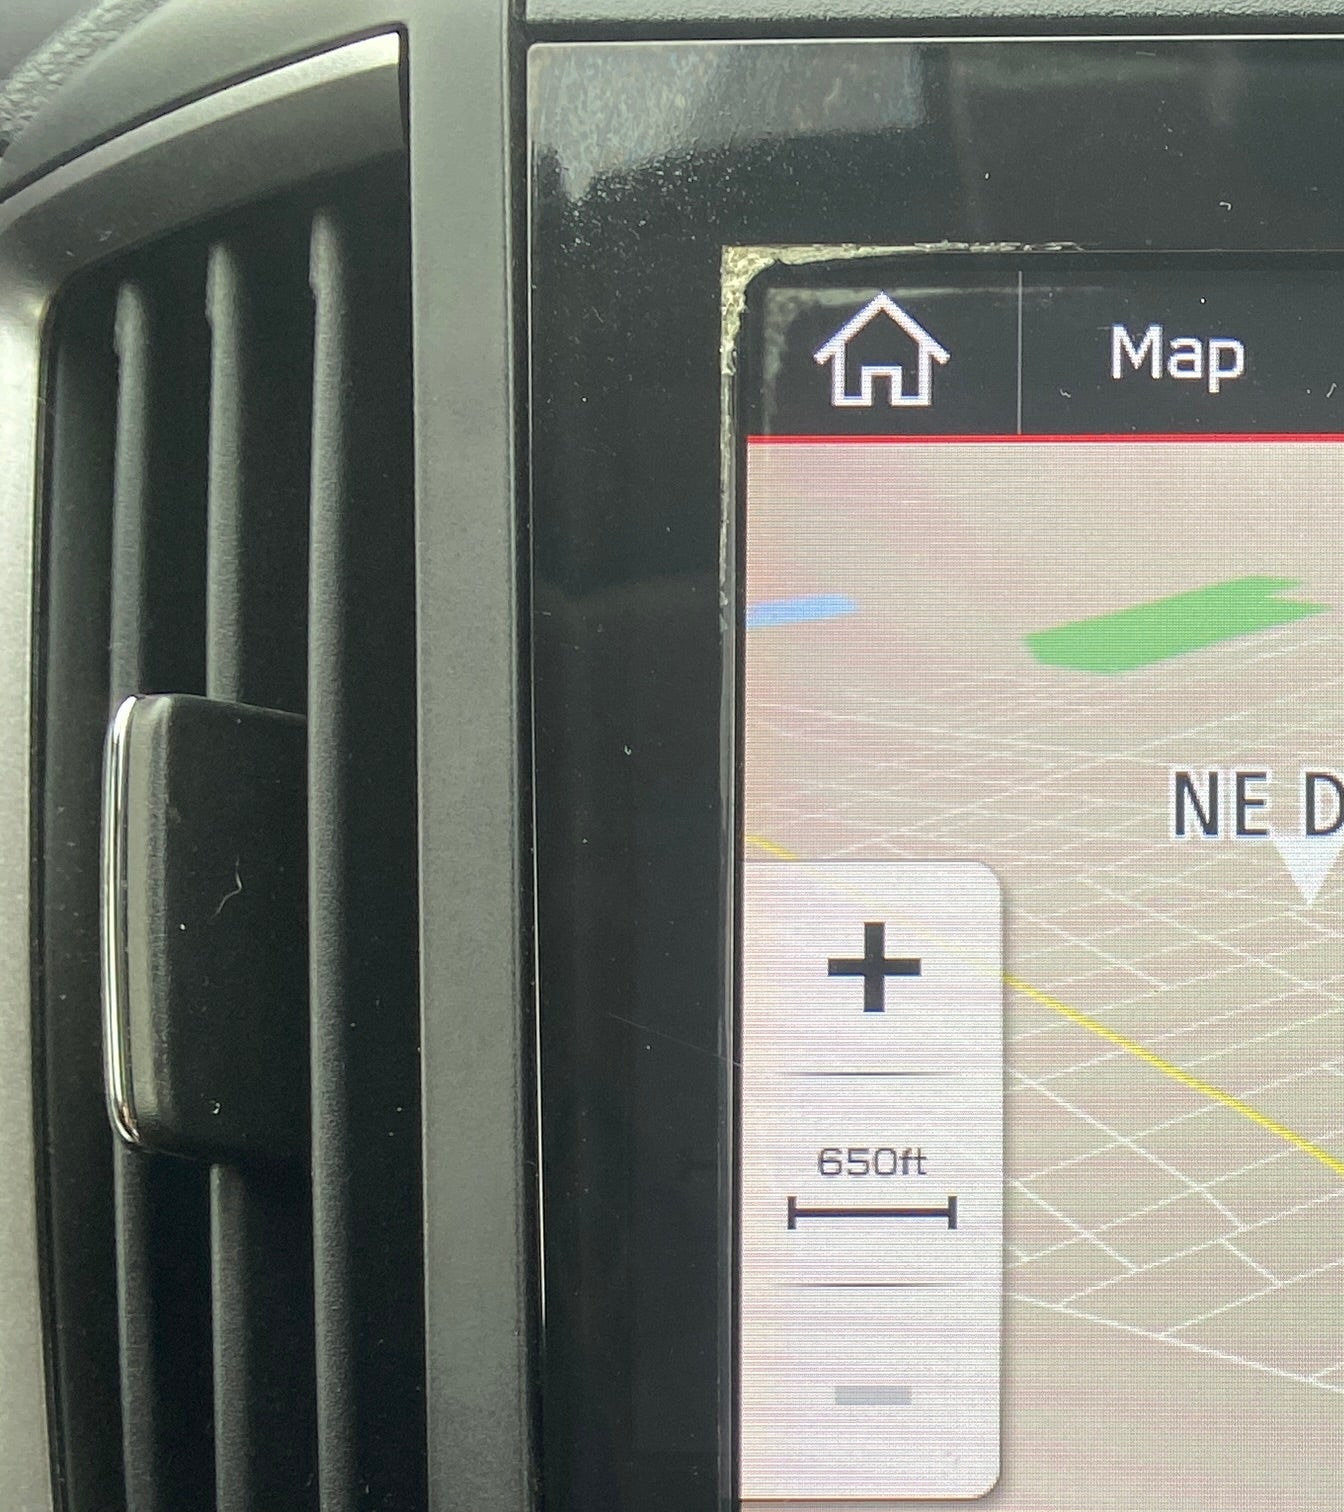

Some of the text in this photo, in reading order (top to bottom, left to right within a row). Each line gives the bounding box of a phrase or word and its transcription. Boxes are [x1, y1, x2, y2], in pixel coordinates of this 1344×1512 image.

[1112, 325, 1245, 394] Map
[1175, 771, 1269, 836] NE
[817, 1147, 928, 1177] 650ft
